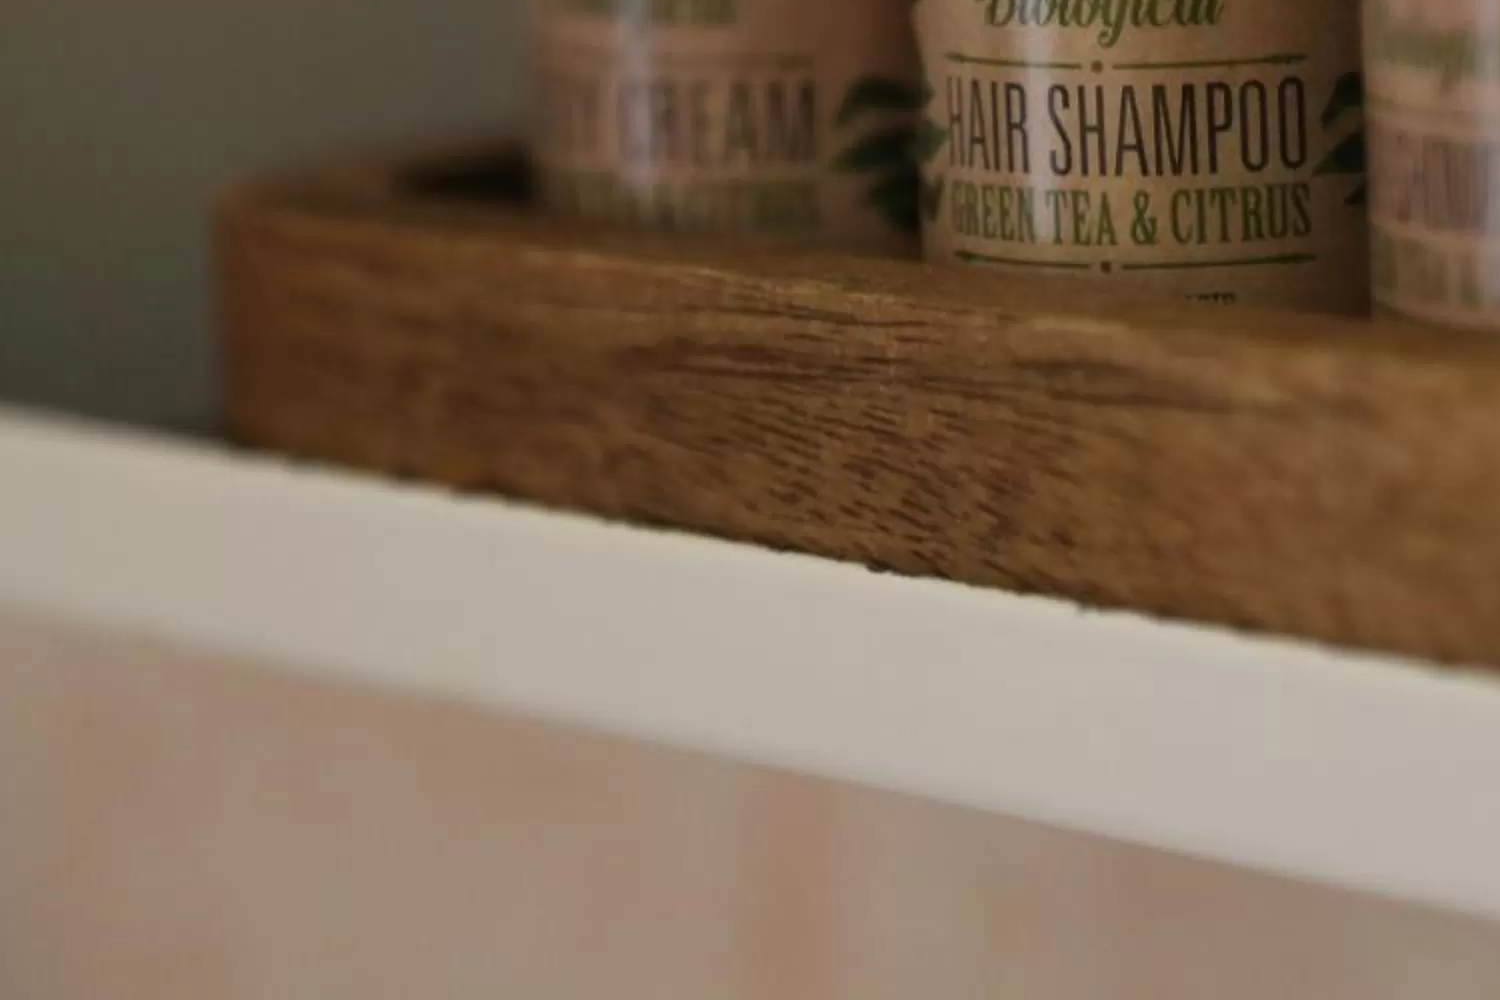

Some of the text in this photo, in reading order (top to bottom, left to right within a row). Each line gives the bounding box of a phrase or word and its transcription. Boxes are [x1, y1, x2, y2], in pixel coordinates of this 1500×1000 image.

[946, 75, 1309, 178] HAIR SHAMPOO
[950, 180, 1037, 244] GREEN
[1047, 187, 1118, 248] TEA
[1129, 188, 1159, 246] &
[1170, 182, 1313, 246] CITRUS
